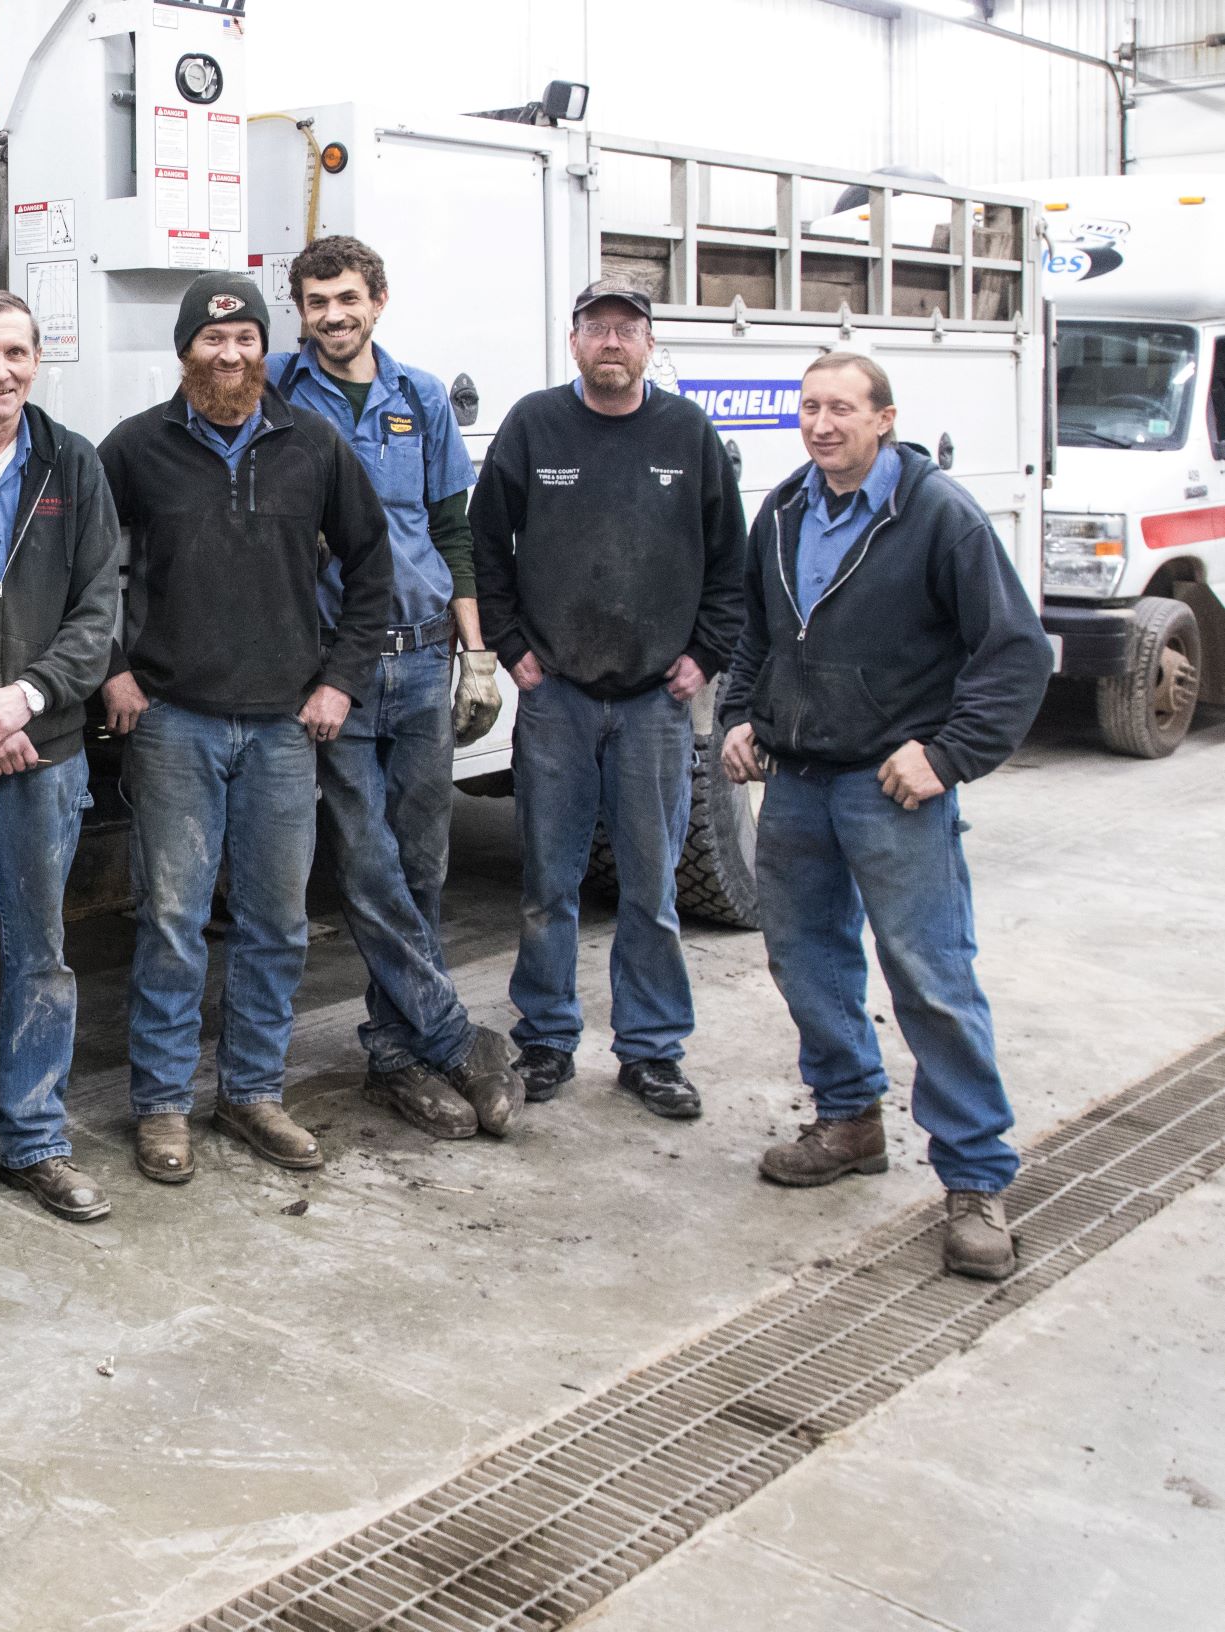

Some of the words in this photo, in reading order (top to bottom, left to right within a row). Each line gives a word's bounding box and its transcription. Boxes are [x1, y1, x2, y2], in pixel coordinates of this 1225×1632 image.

[216, 115, 237, 123] DANGER
[164, 171, 185, 179] DANGER
[216, 175, 238, 183] DANGER
[23, 204, 44, 212] DANGER
[61, 335, 77, 344] 6000
[683, 389, 801, 417] MICHELIN
